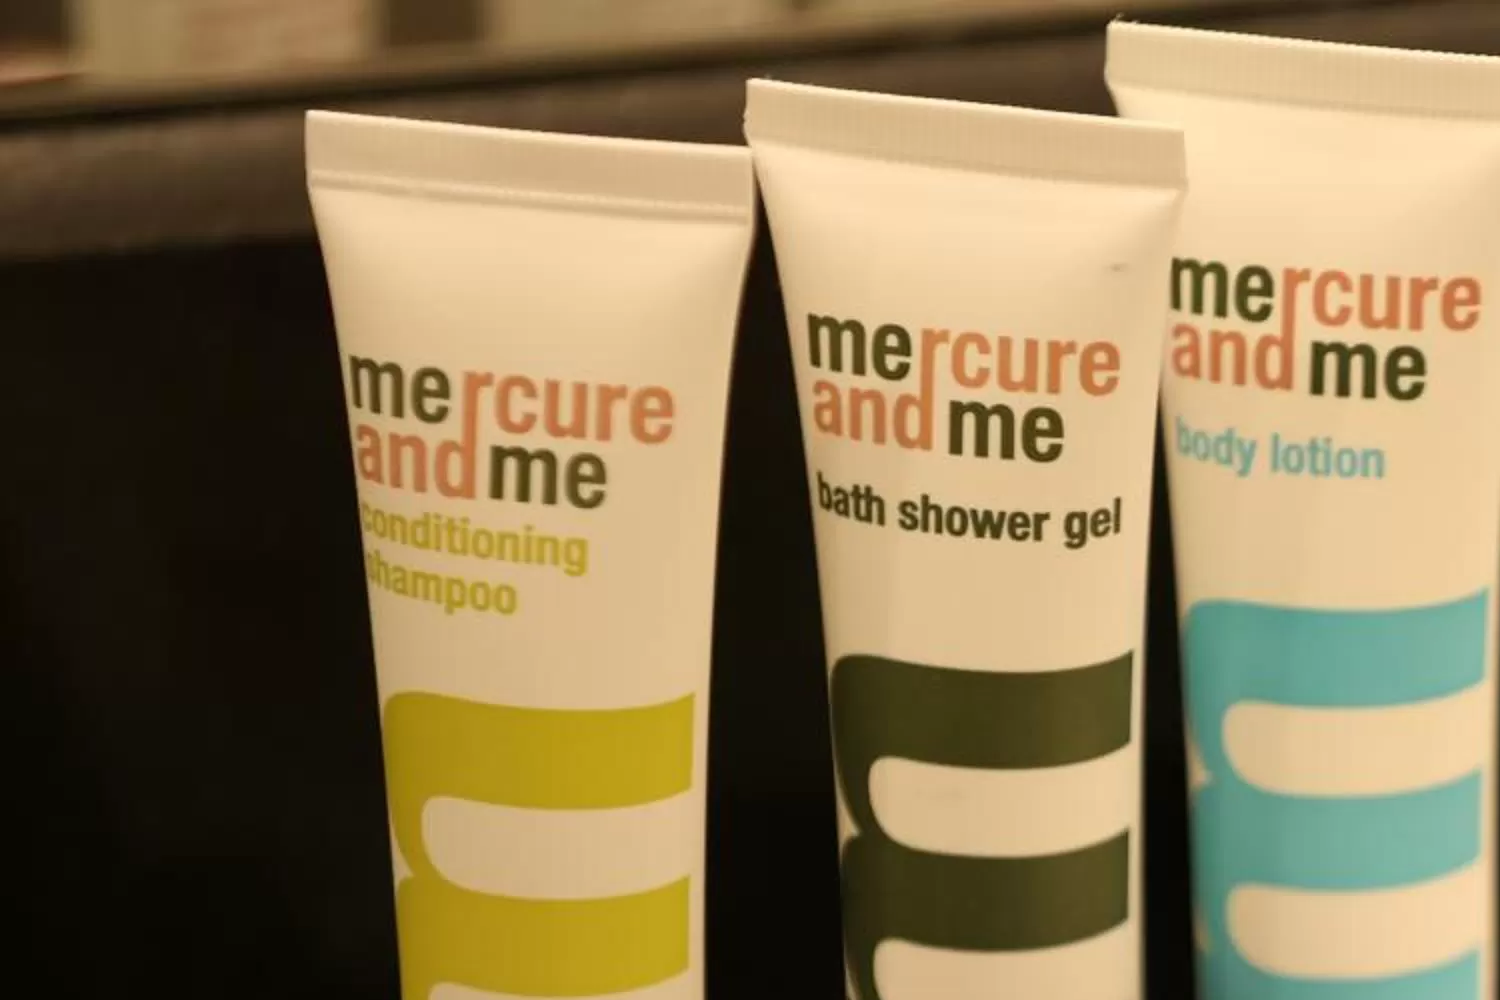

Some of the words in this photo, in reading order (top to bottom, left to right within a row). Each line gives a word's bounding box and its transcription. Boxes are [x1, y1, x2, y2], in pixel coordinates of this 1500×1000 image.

[1170, 256, 1482, 331] mercure
[806, 312, 1121, 396] mercure
[1171, 321, 1295, 391] and
[1308, 340, 1427, 401] me
[348, 354, 676, 444] mercure
[812, 378, 934, 451] and
[947, 400, 1065, 463] me
[355, 421, 477, 500] and
[488, 444, 607, 510] me
[1175, 414, 1257, 478] body
[1269, 431, 1386, 479] lotion
[361, 502, 589, 577] conditioning
[816, 470, 885, 526] bath
[897, 494, 1050, 541] shower
[1063, 497, 1122, 550] gel
